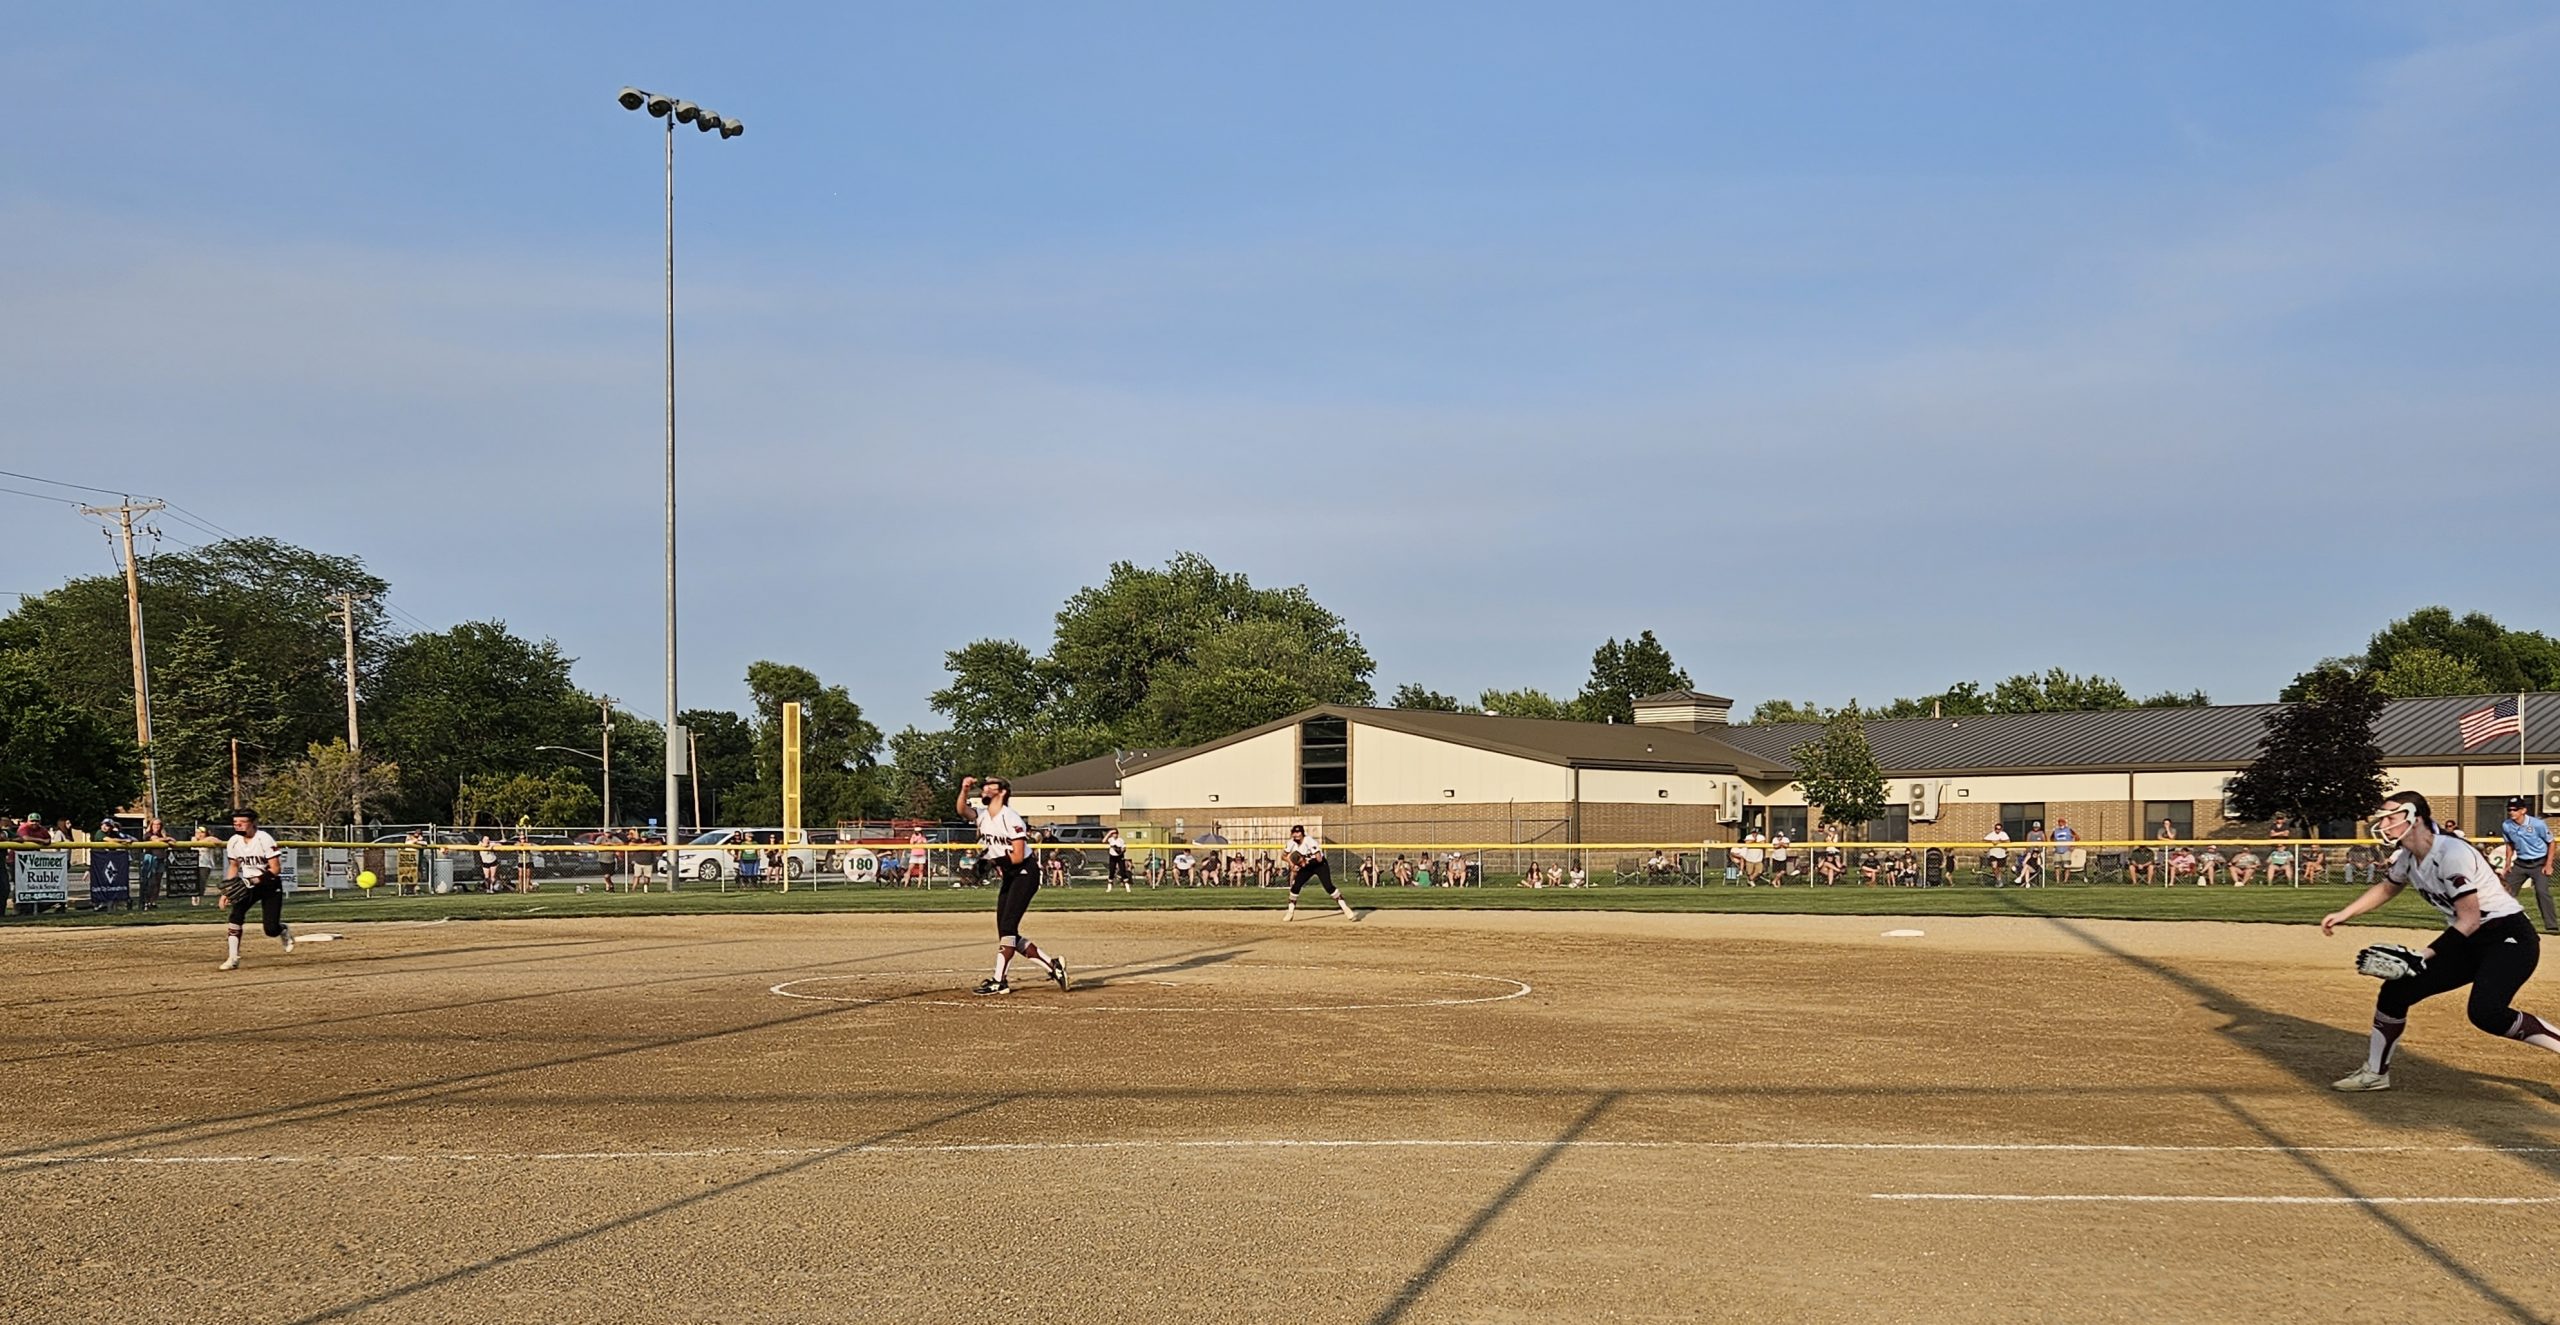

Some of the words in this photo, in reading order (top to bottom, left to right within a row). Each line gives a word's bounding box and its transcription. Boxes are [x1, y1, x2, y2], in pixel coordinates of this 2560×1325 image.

[28, 854, 63, 867] Vermeer
[848, 858, 873, 870] 180
[27, 871, 60, 883] Ruble
